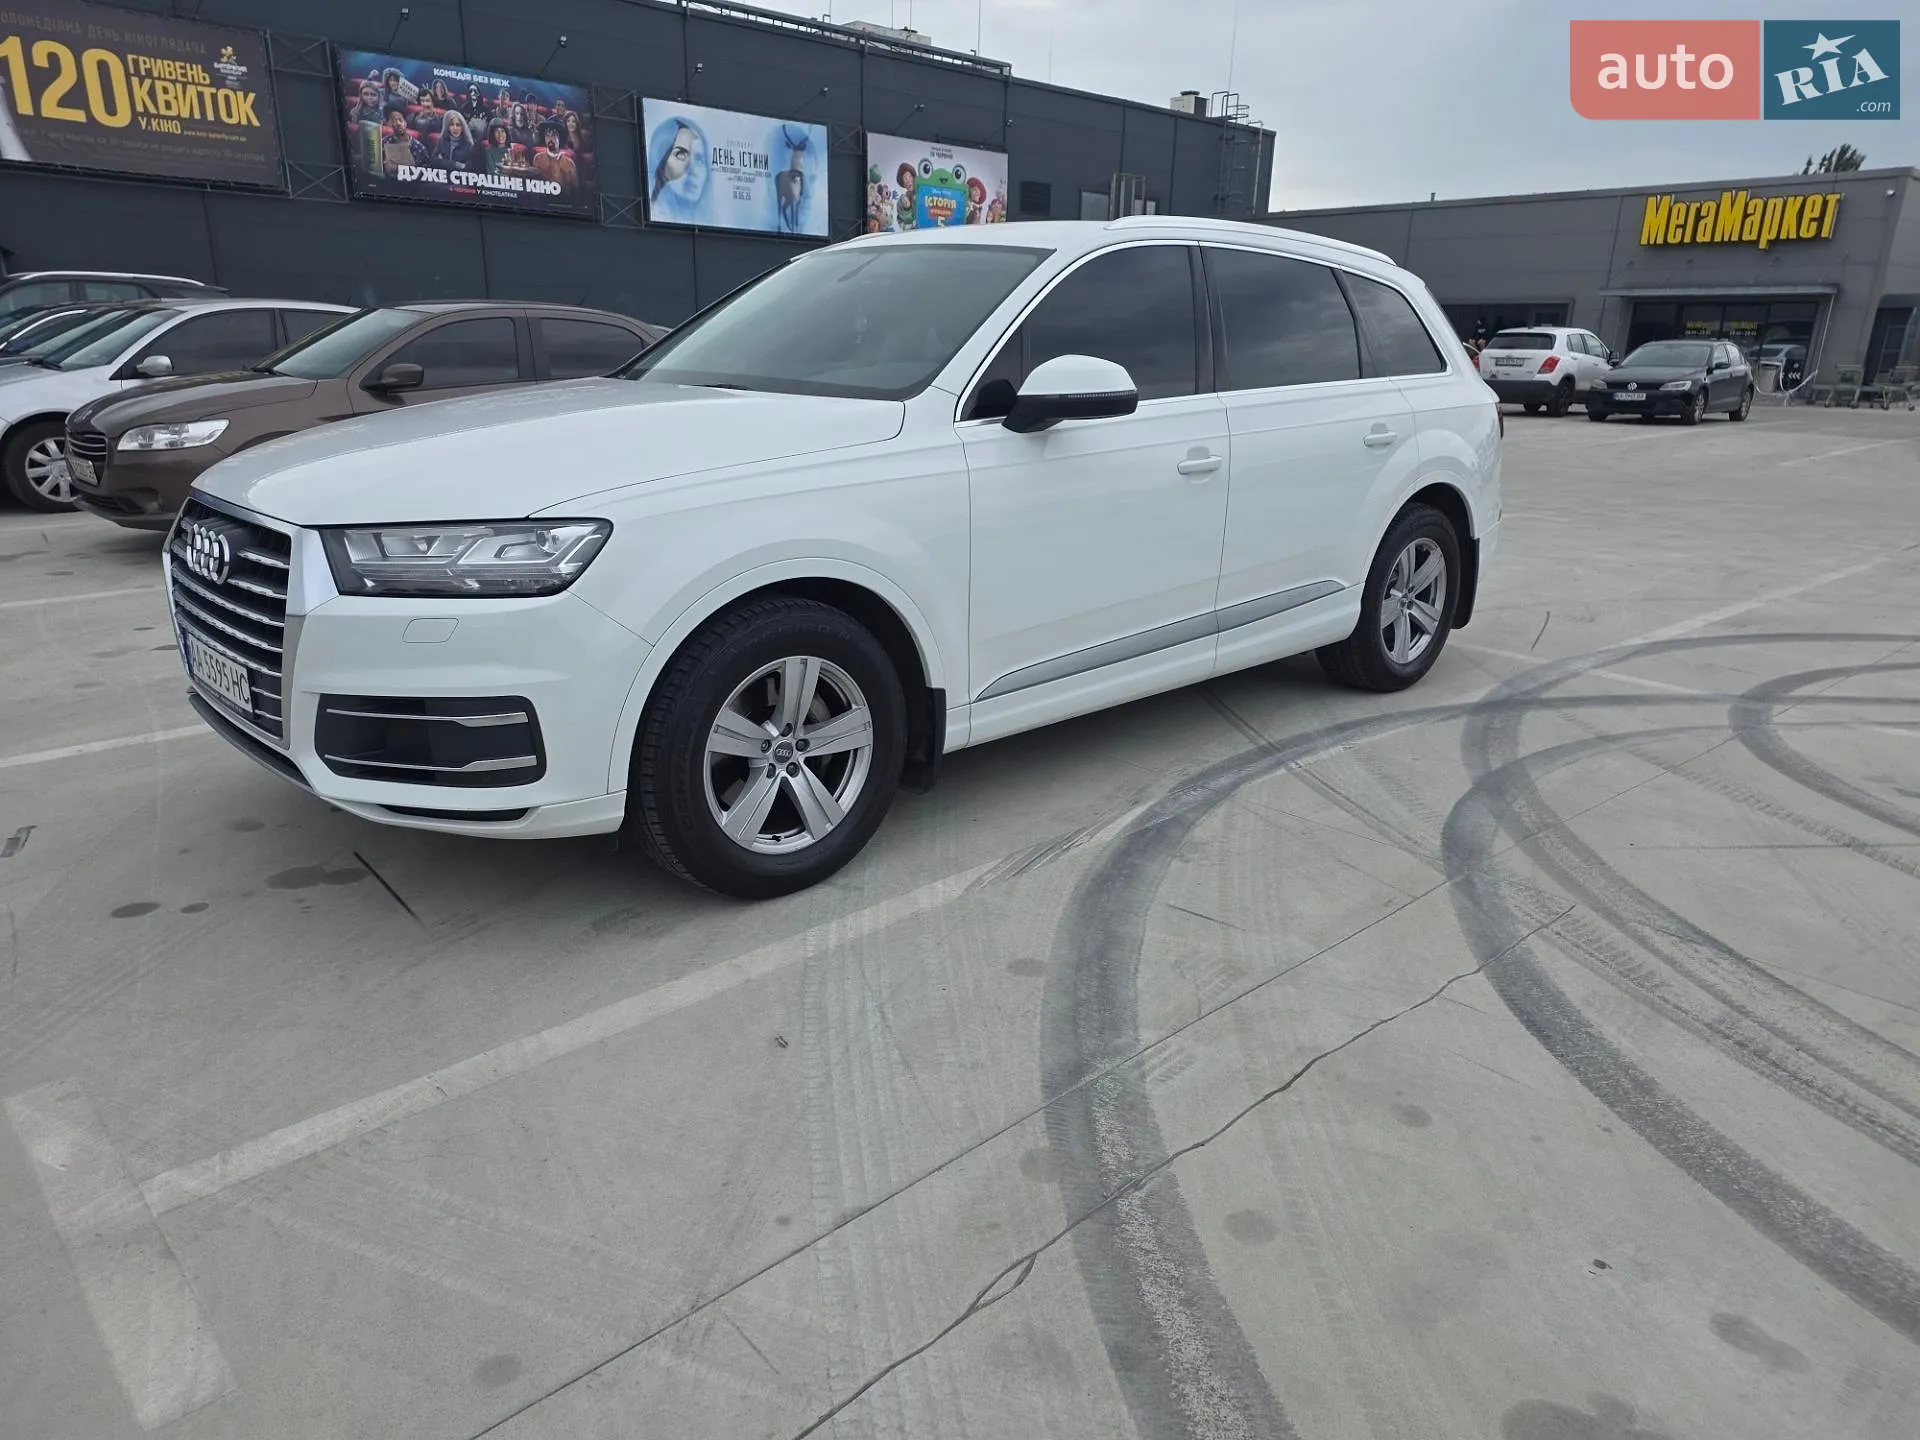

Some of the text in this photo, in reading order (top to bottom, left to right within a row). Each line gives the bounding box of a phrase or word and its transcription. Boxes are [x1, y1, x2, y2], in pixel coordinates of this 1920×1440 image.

[0, 35, 132, 128] 120
[126, 53, 210, 85] ГРИВЕНЬ
[433, 67, 511, 88] КОМЕДІЯ БЕЗ МЕЖ
[130, 76, 261, 128] КВИТОК
[712, 147, 769, 171] ДЕНЬ ІСТИНИ
[397, 164, 562, 196] ДУЖЕ СТРАШНЕ КІНО
[924, 195, 957, 209] ІСТОРІЯ
[1640, 190, 1841, 250] МегаМаркет
